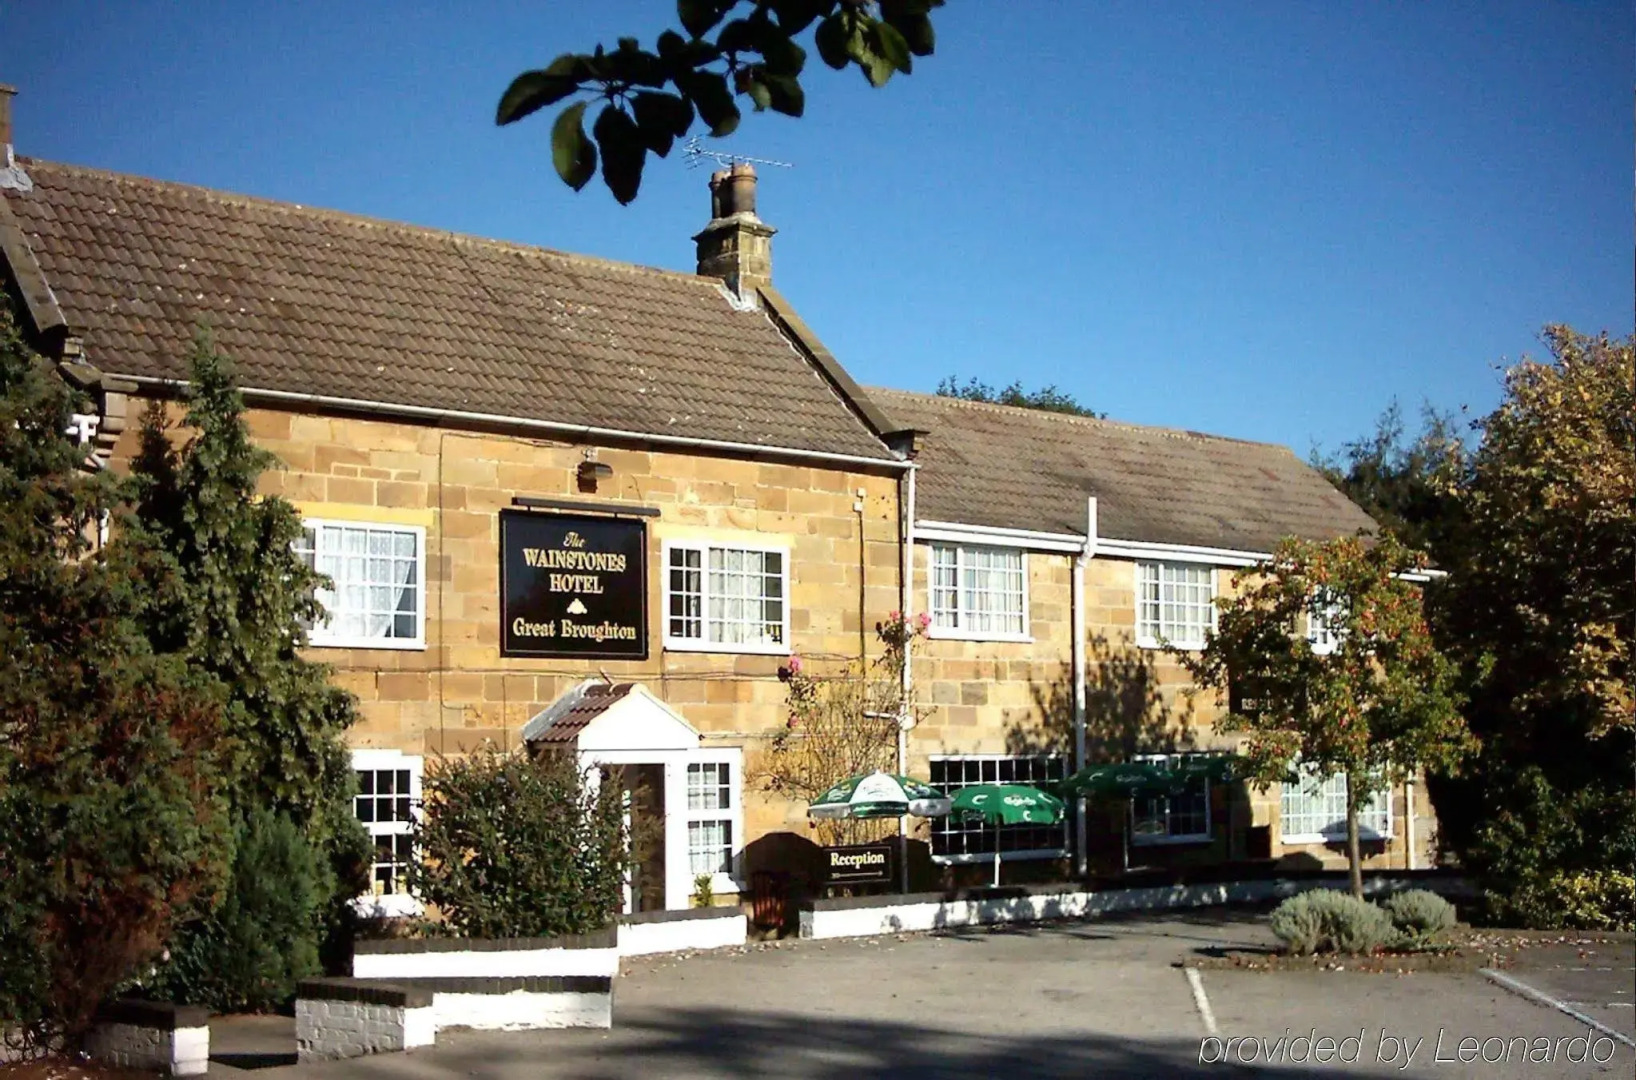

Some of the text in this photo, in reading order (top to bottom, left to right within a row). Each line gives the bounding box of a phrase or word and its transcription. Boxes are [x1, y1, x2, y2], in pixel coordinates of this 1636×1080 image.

[563, 532, 585, 547] The
[523, 548, 626, 572] WAINSTONES
[549, 573, 603, 594] HOTEL
[513, 617, 636, 642] Great Broughton
[830, 851, 885, 869] Reception
